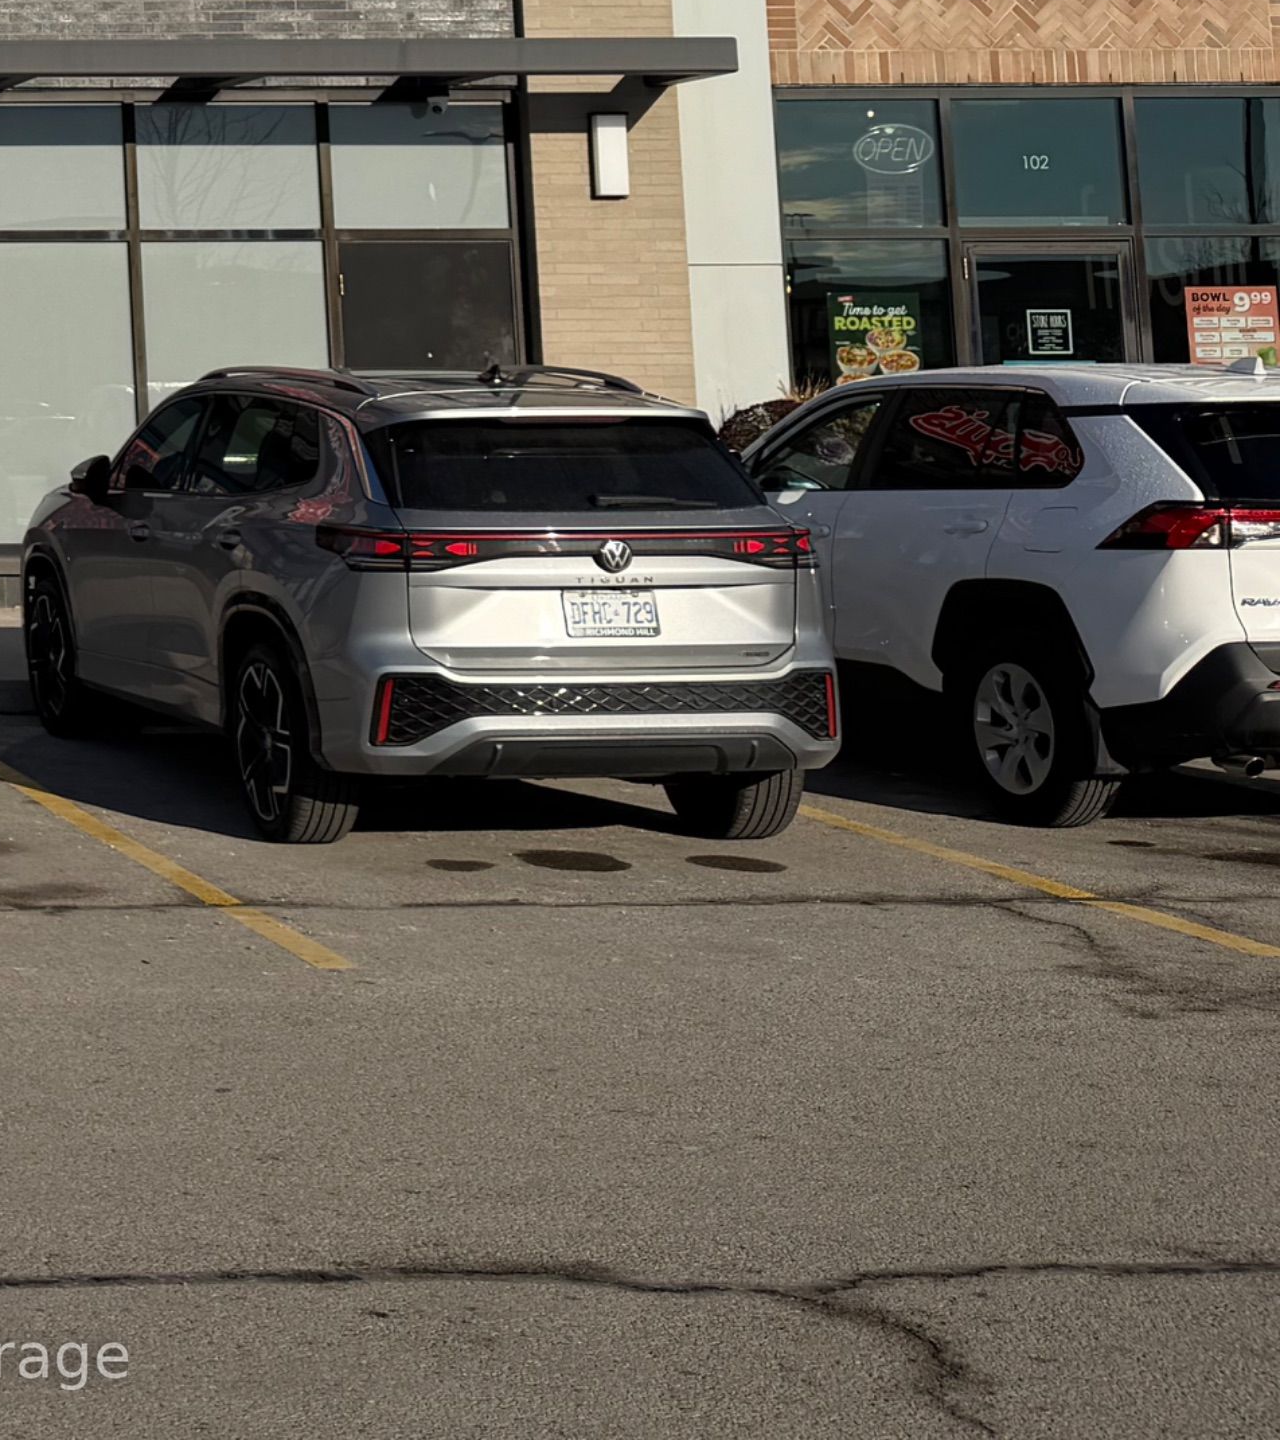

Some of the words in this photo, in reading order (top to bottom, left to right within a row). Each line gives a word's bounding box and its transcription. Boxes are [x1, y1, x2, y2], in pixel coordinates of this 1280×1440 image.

[858, 137, 926, 161] OPEN
[1022, 155, 1050, 170] 102
[1191, 292, 1230, 302] BOWL
[842, 302, 871, 316] Time
[834, 316, 917, 331] ROASTED
[576, 576, 655, 585] TIGUAN
[570, 601, 613, 625] DFHC
[621, 601, 655, 624] 729
